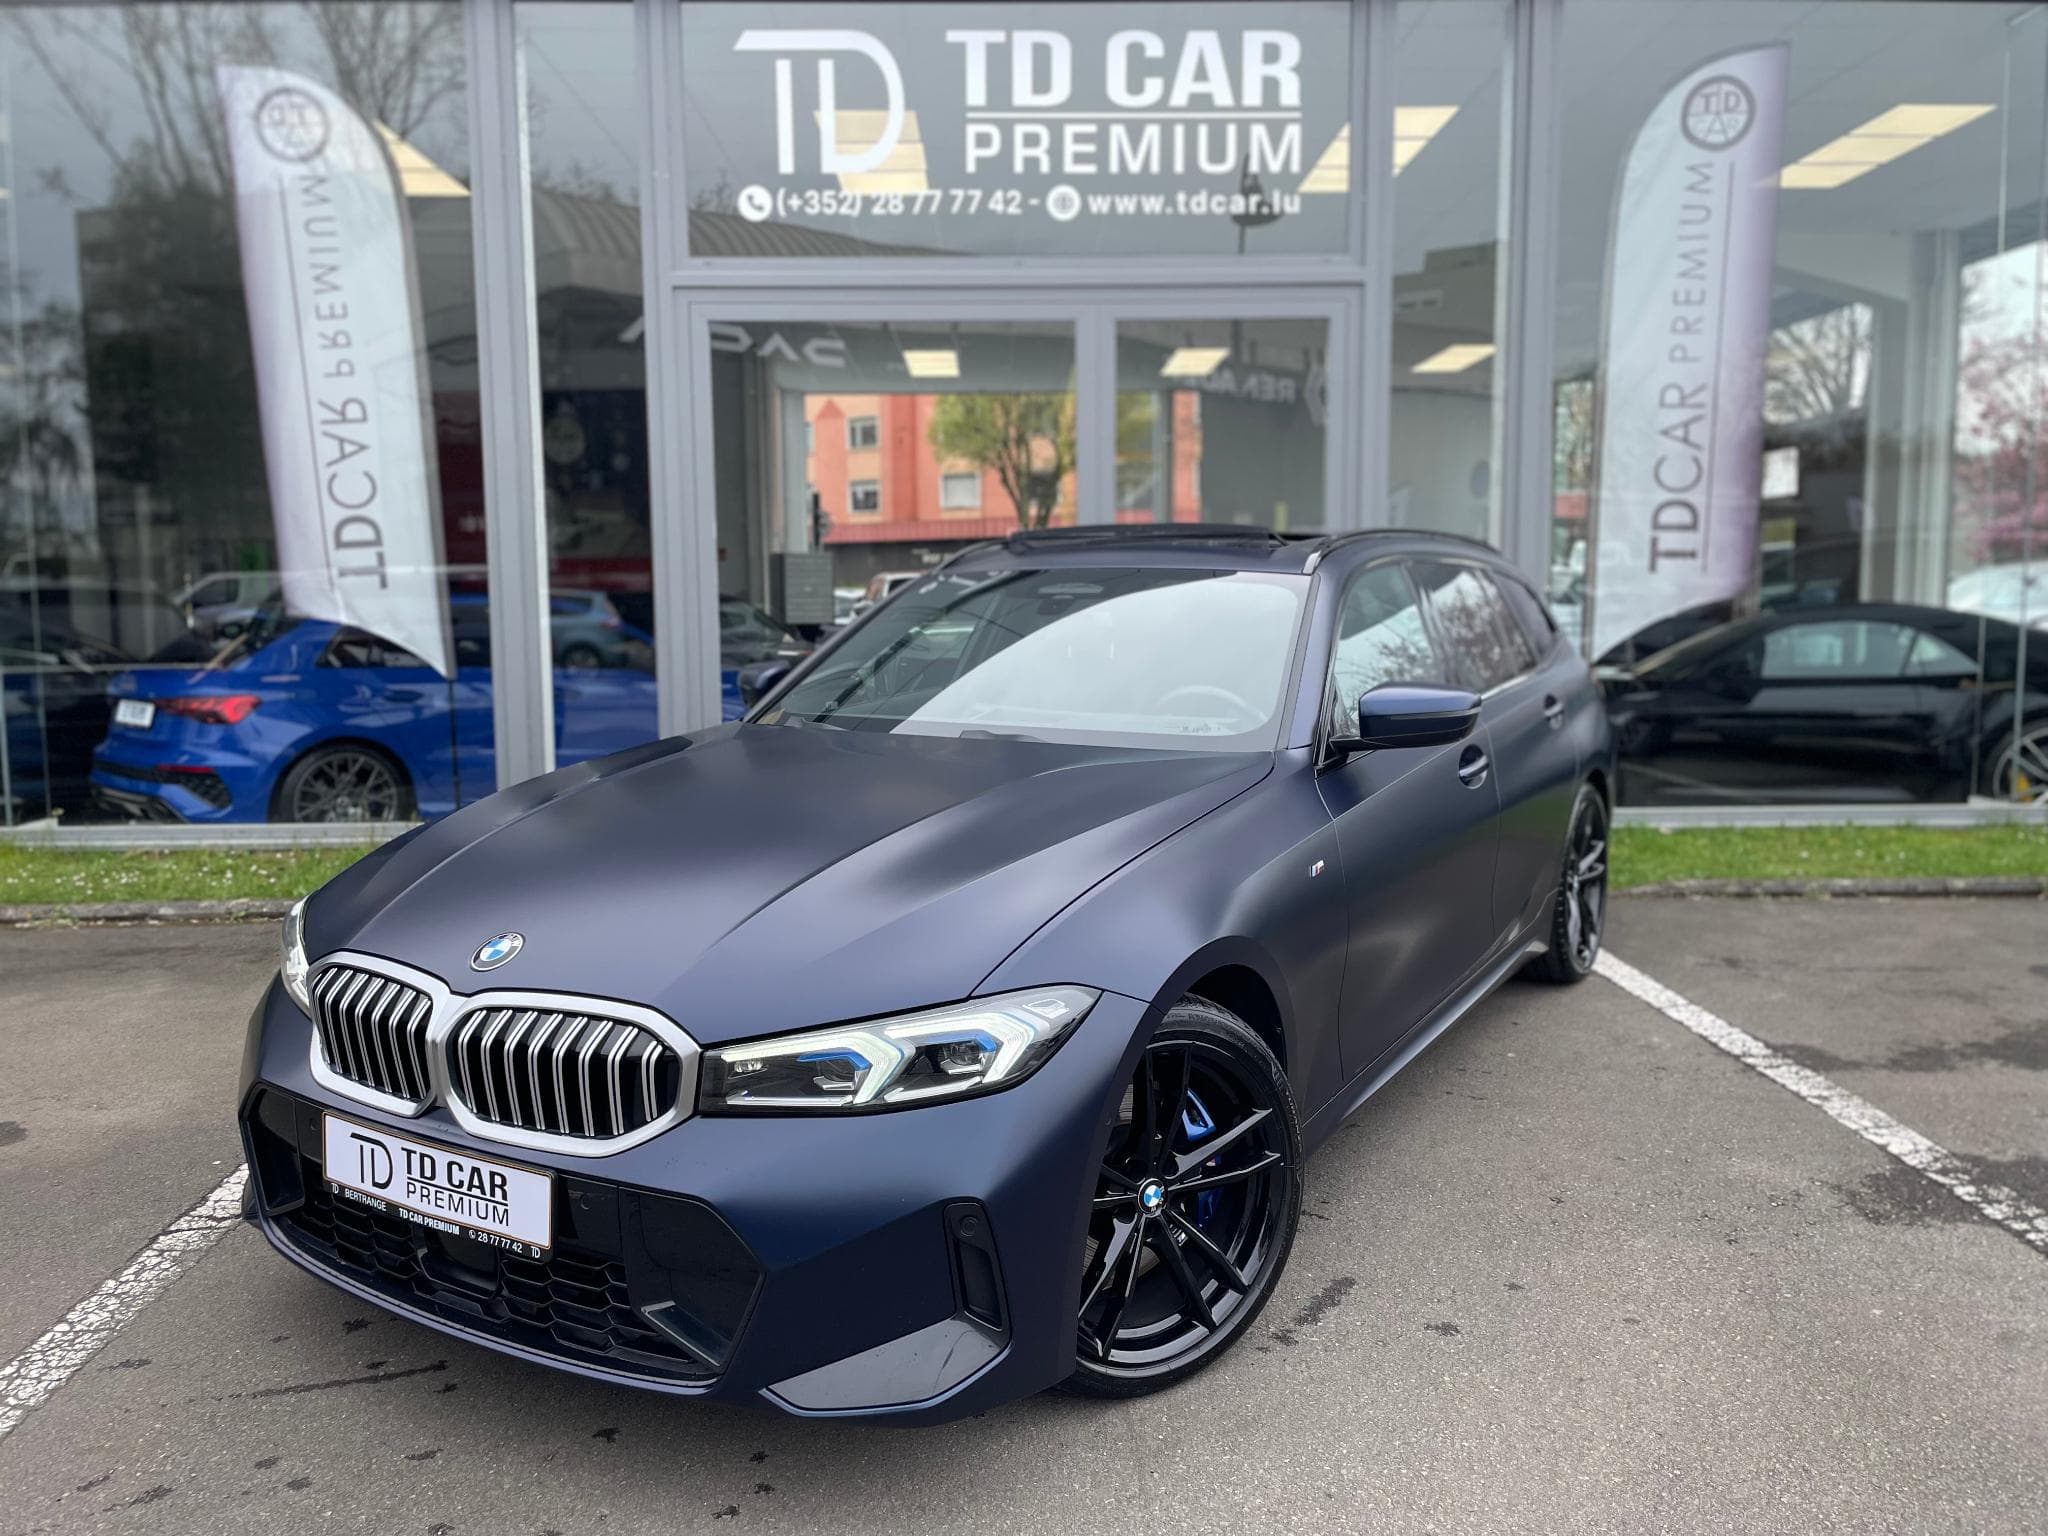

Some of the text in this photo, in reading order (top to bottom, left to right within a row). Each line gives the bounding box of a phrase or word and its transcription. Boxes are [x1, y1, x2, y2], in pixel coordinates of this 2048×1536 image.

[946, 30, 1303, 108] TD CAR
[1699, 90, 1741, 113] TD
[965, 124, 1303, 175] PREMIUM
[775, 189, 864, 217] (+352)
[871, 190, 906, 216] 28
[909, 190, 944, 216] 77
[949, 190, 984, 216] 77
[988, 190, 1022, 216] 42
[1088, 188, 1303, 217] www.tdcar.lu
[1649, 160, 1714, 575] TDCAR PREMIUM
[401, 1146, 508, 1202] TD CAR
[344, 1189, 388, 1212] BERTRANGE
[399, 1207, 410, 1220] TD
[409, 1210, 424, 1226] CAR
[423, 1214, 460, 1236] PREMIUM
[477, 1231, 489, 1245] 28
[489, 1235, 501, 1248] 77
[501, 1238, 512, 1250] 77
[510, 1240, 523, 1253] 42
[406, 1181, 510, 1227] PREMIUM
